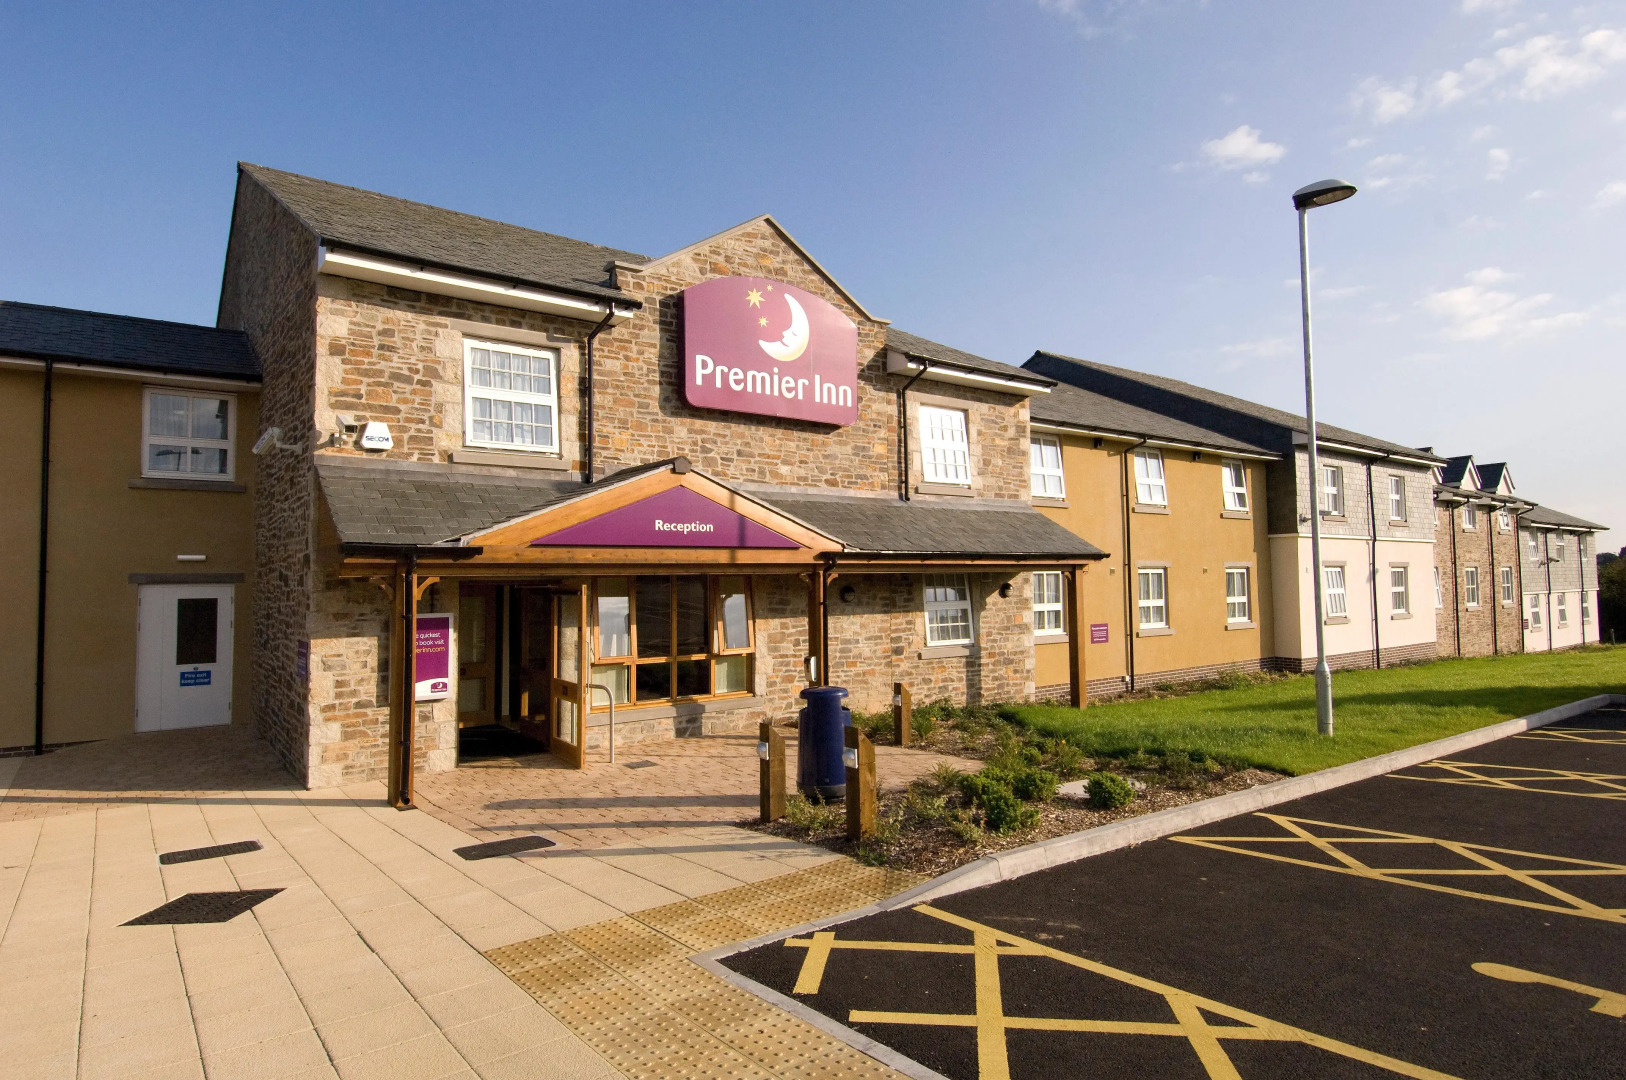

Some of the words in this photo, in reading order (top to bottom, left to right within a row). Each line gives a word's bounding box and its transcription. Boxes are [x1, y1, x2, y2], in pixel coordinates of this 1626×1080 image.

[695, 354, 810, 400] Premier
[814, 374, 853, 408] Inn
[655, 519, 714, 535] Reception
